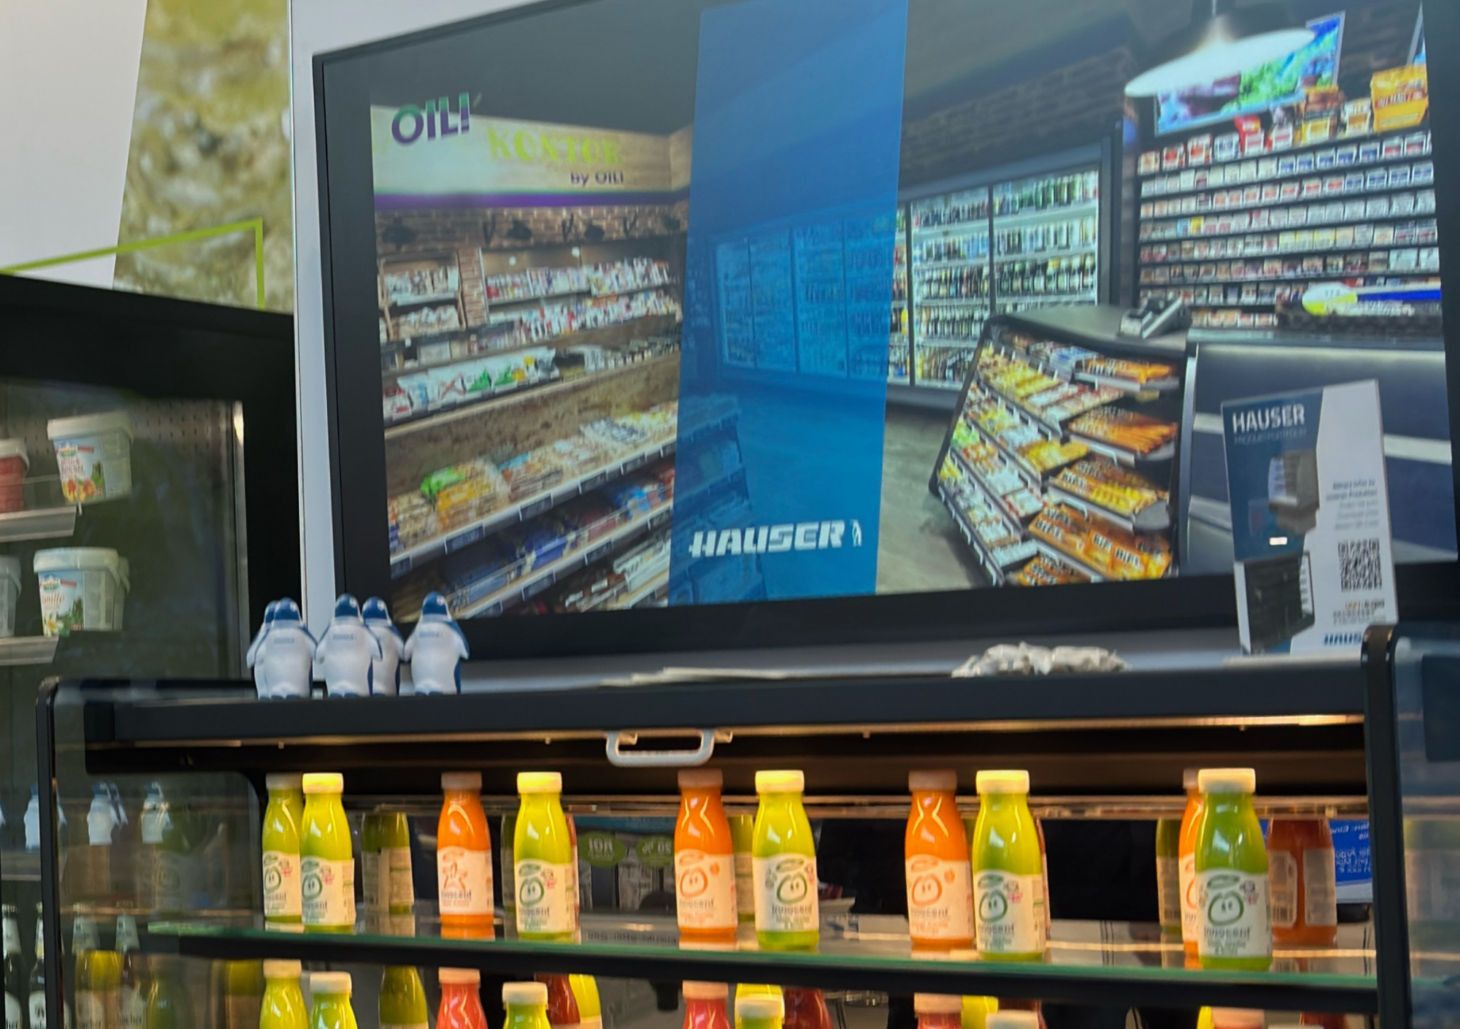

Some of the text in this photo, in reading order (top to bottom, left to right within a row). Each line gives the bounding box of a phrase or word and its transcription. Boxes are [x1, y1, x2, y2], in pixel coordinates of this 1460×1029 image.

[487, 126, 623, 165] KONTOR
[1232, 403, 1306, 434] HAUSER
[690, 520, 845, 558] HAUSER
[1324, 631, 1363, 646] HAUS
